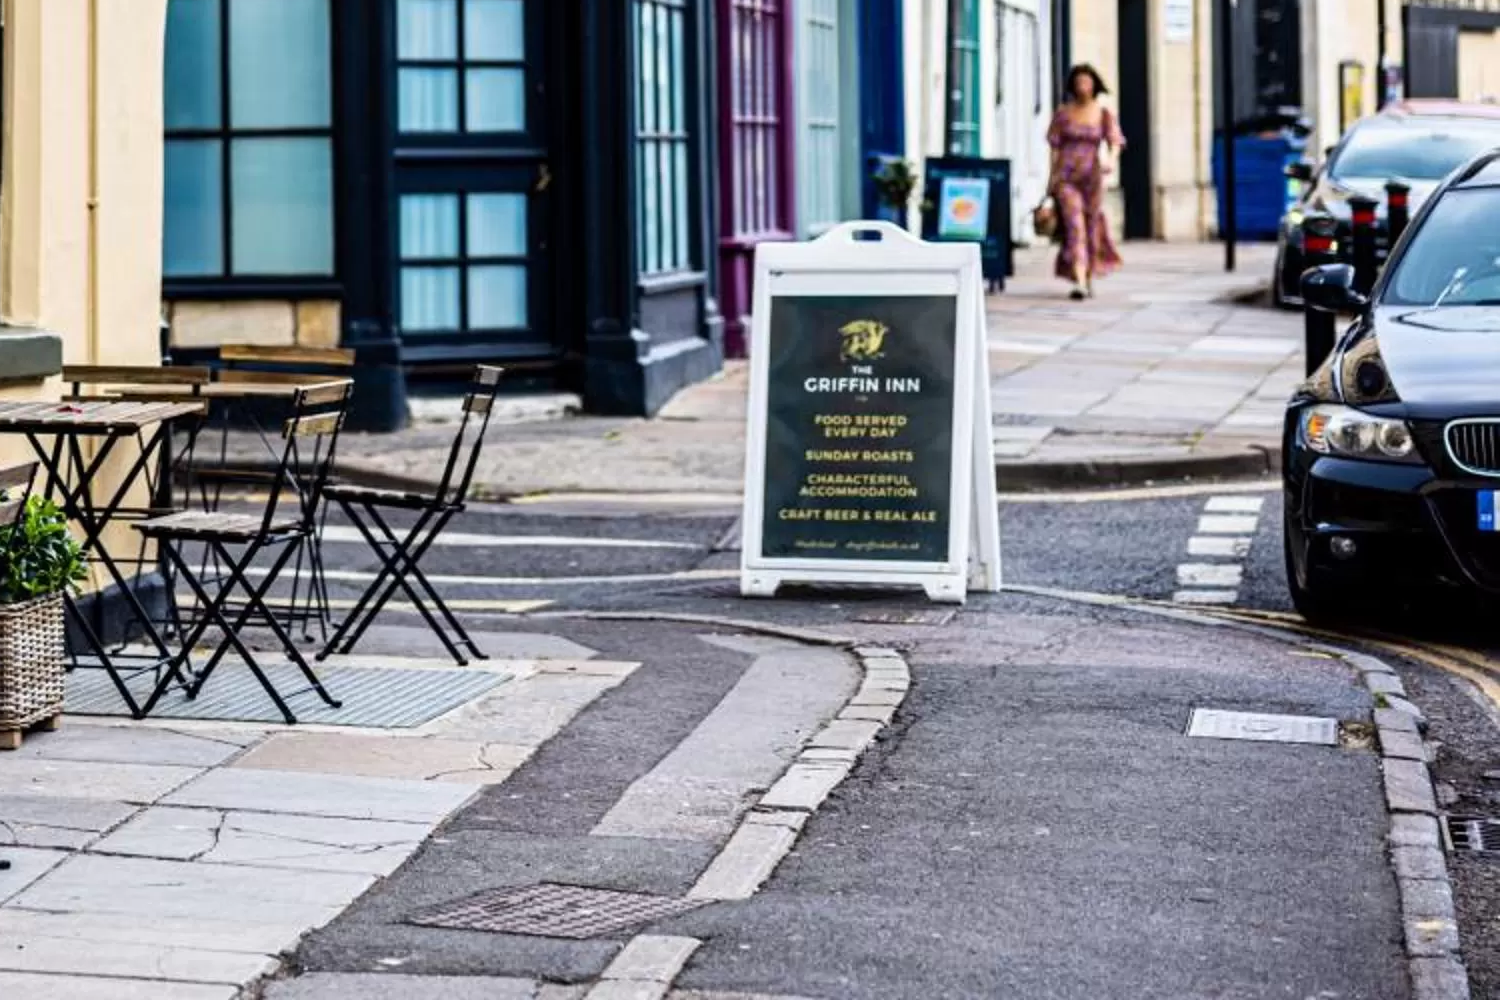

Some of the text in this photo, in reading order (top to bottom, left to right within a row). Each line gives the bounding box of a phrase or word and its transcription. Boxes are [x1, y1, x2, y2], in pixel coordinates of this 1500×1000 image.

[852, 365, 873, 375] THE
[803, 377, 921, 393] GRIFFIN INN
[815, 415, 908, 427] FOOD SERVED
[824, 427, 897, 438] EVERY DAY
[804, 450, 914, 463] SUNDAY ROASTS
[808, 474, 911, 486] CHARACTERFUL
[799, 486, 918, 498] ACCOMMODATION
[778, 509, 821, 521] CRAFT
[824, 509, 860, 522] BEER
[875, 510, 908, 522] REAL
[911, 511, 937, 523] ALE
